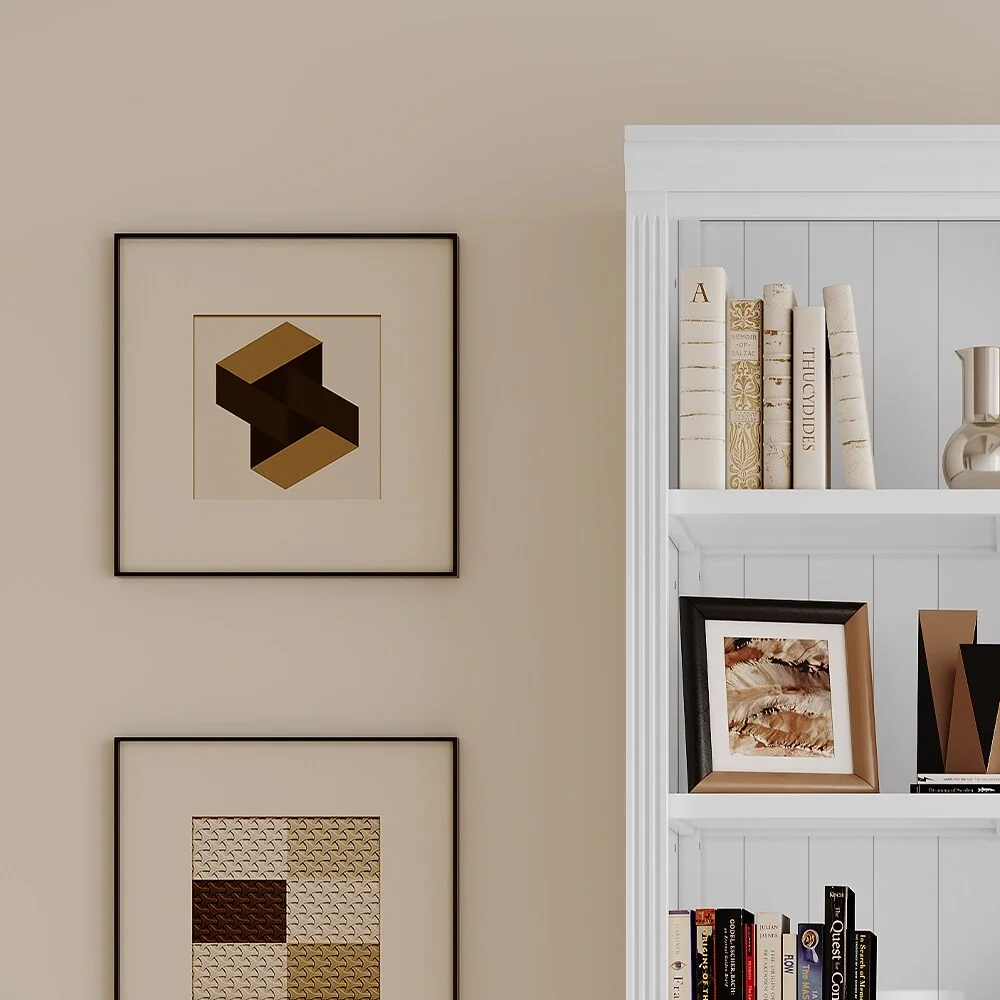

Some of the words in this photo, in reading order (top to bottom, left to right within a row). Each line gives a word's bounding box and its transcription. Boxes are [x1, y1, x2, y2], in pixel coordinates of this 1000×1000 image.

[691, 283, 711, 303] A
[802, 347, 816, 451] THUCYDIDES
[830, 920, 844, 961] Quest
[784, 954, 794, 975] FLOW
[802, 964, 811, 980] The
[702, 969, 709, 983] OF
[771, 992, 776, 1000] OF
